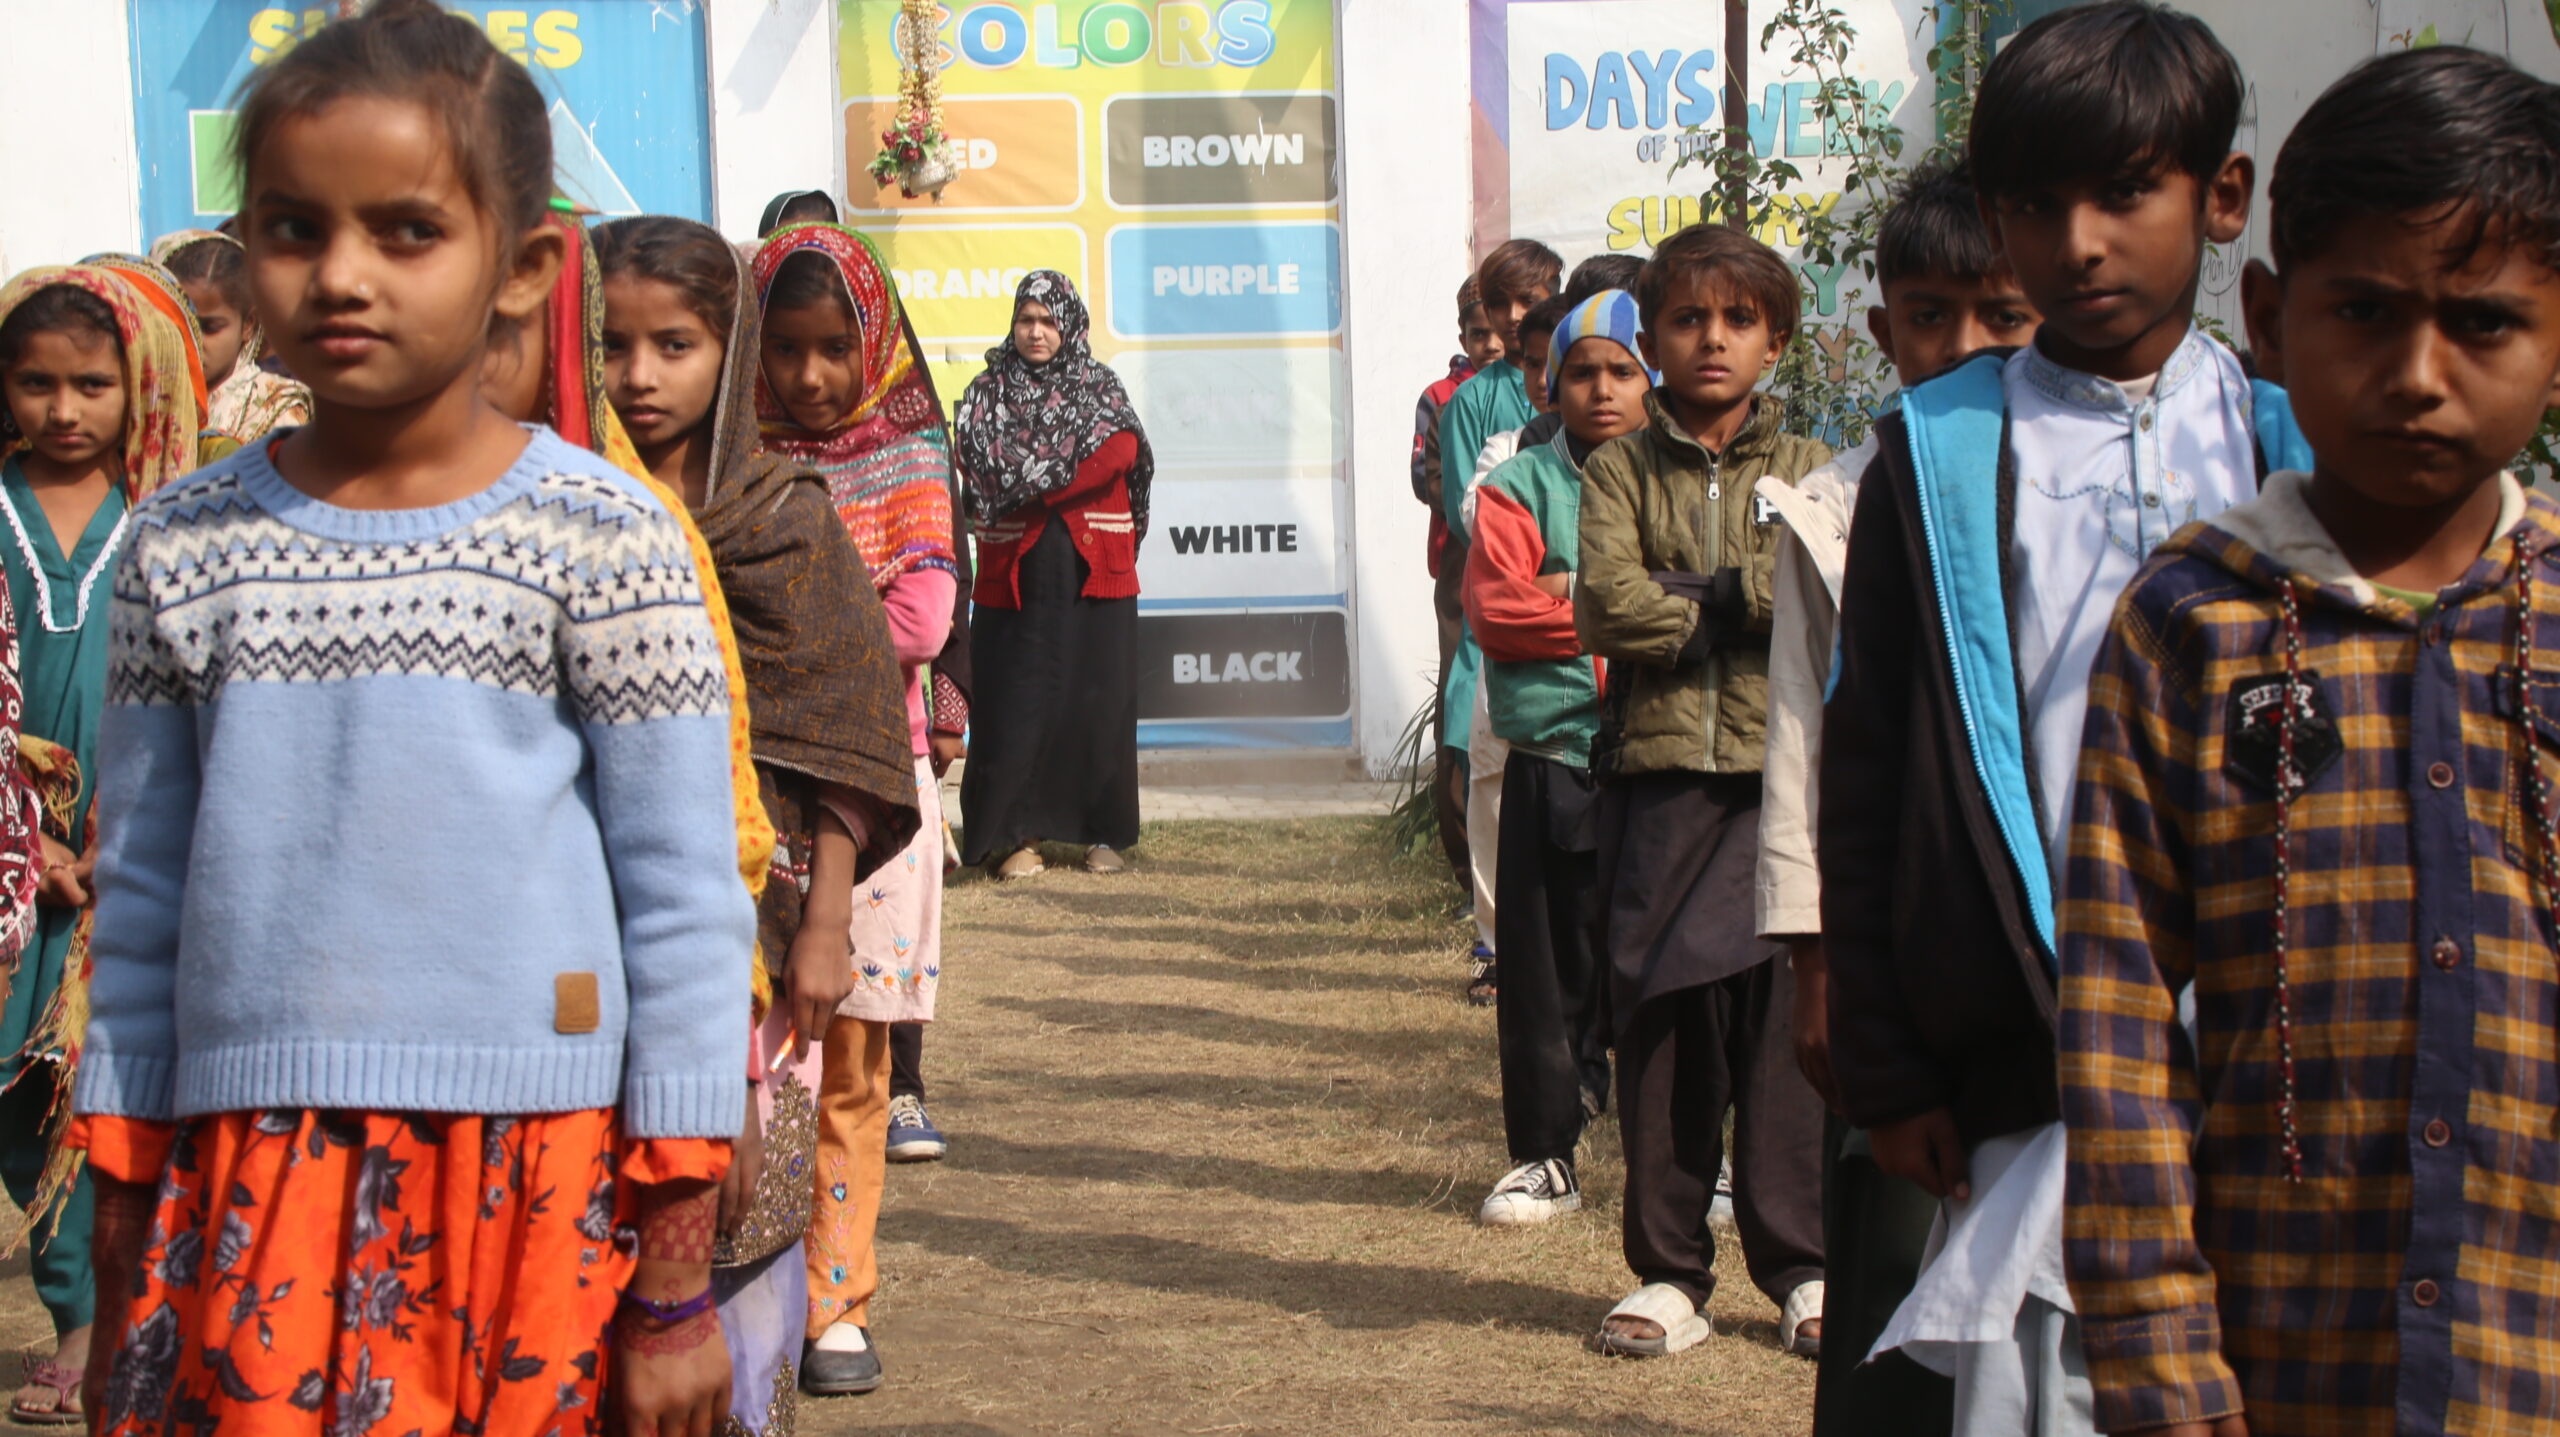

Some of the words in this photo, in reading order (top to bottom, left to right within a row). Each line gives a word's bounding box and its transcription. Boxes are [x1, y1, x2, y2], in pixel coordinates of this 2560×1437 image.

[249, 9, 583, 69] SES
[1545, 48, 1716, 131] DAYS
[1719, 79, 1904, 160] WEEK
[1143, 133, 1304, 168] BROWN
[1637, 134, 1666, 163] OF
[1607, 191, 1841, 250] SUNAY
[890, 265, 1053, 301] ORANG
[1153, 263, 1300, 297] PURPLE
[1169, 524, 1298, 554] WHITE
[1172, 651, 1303, 684] BLACK
